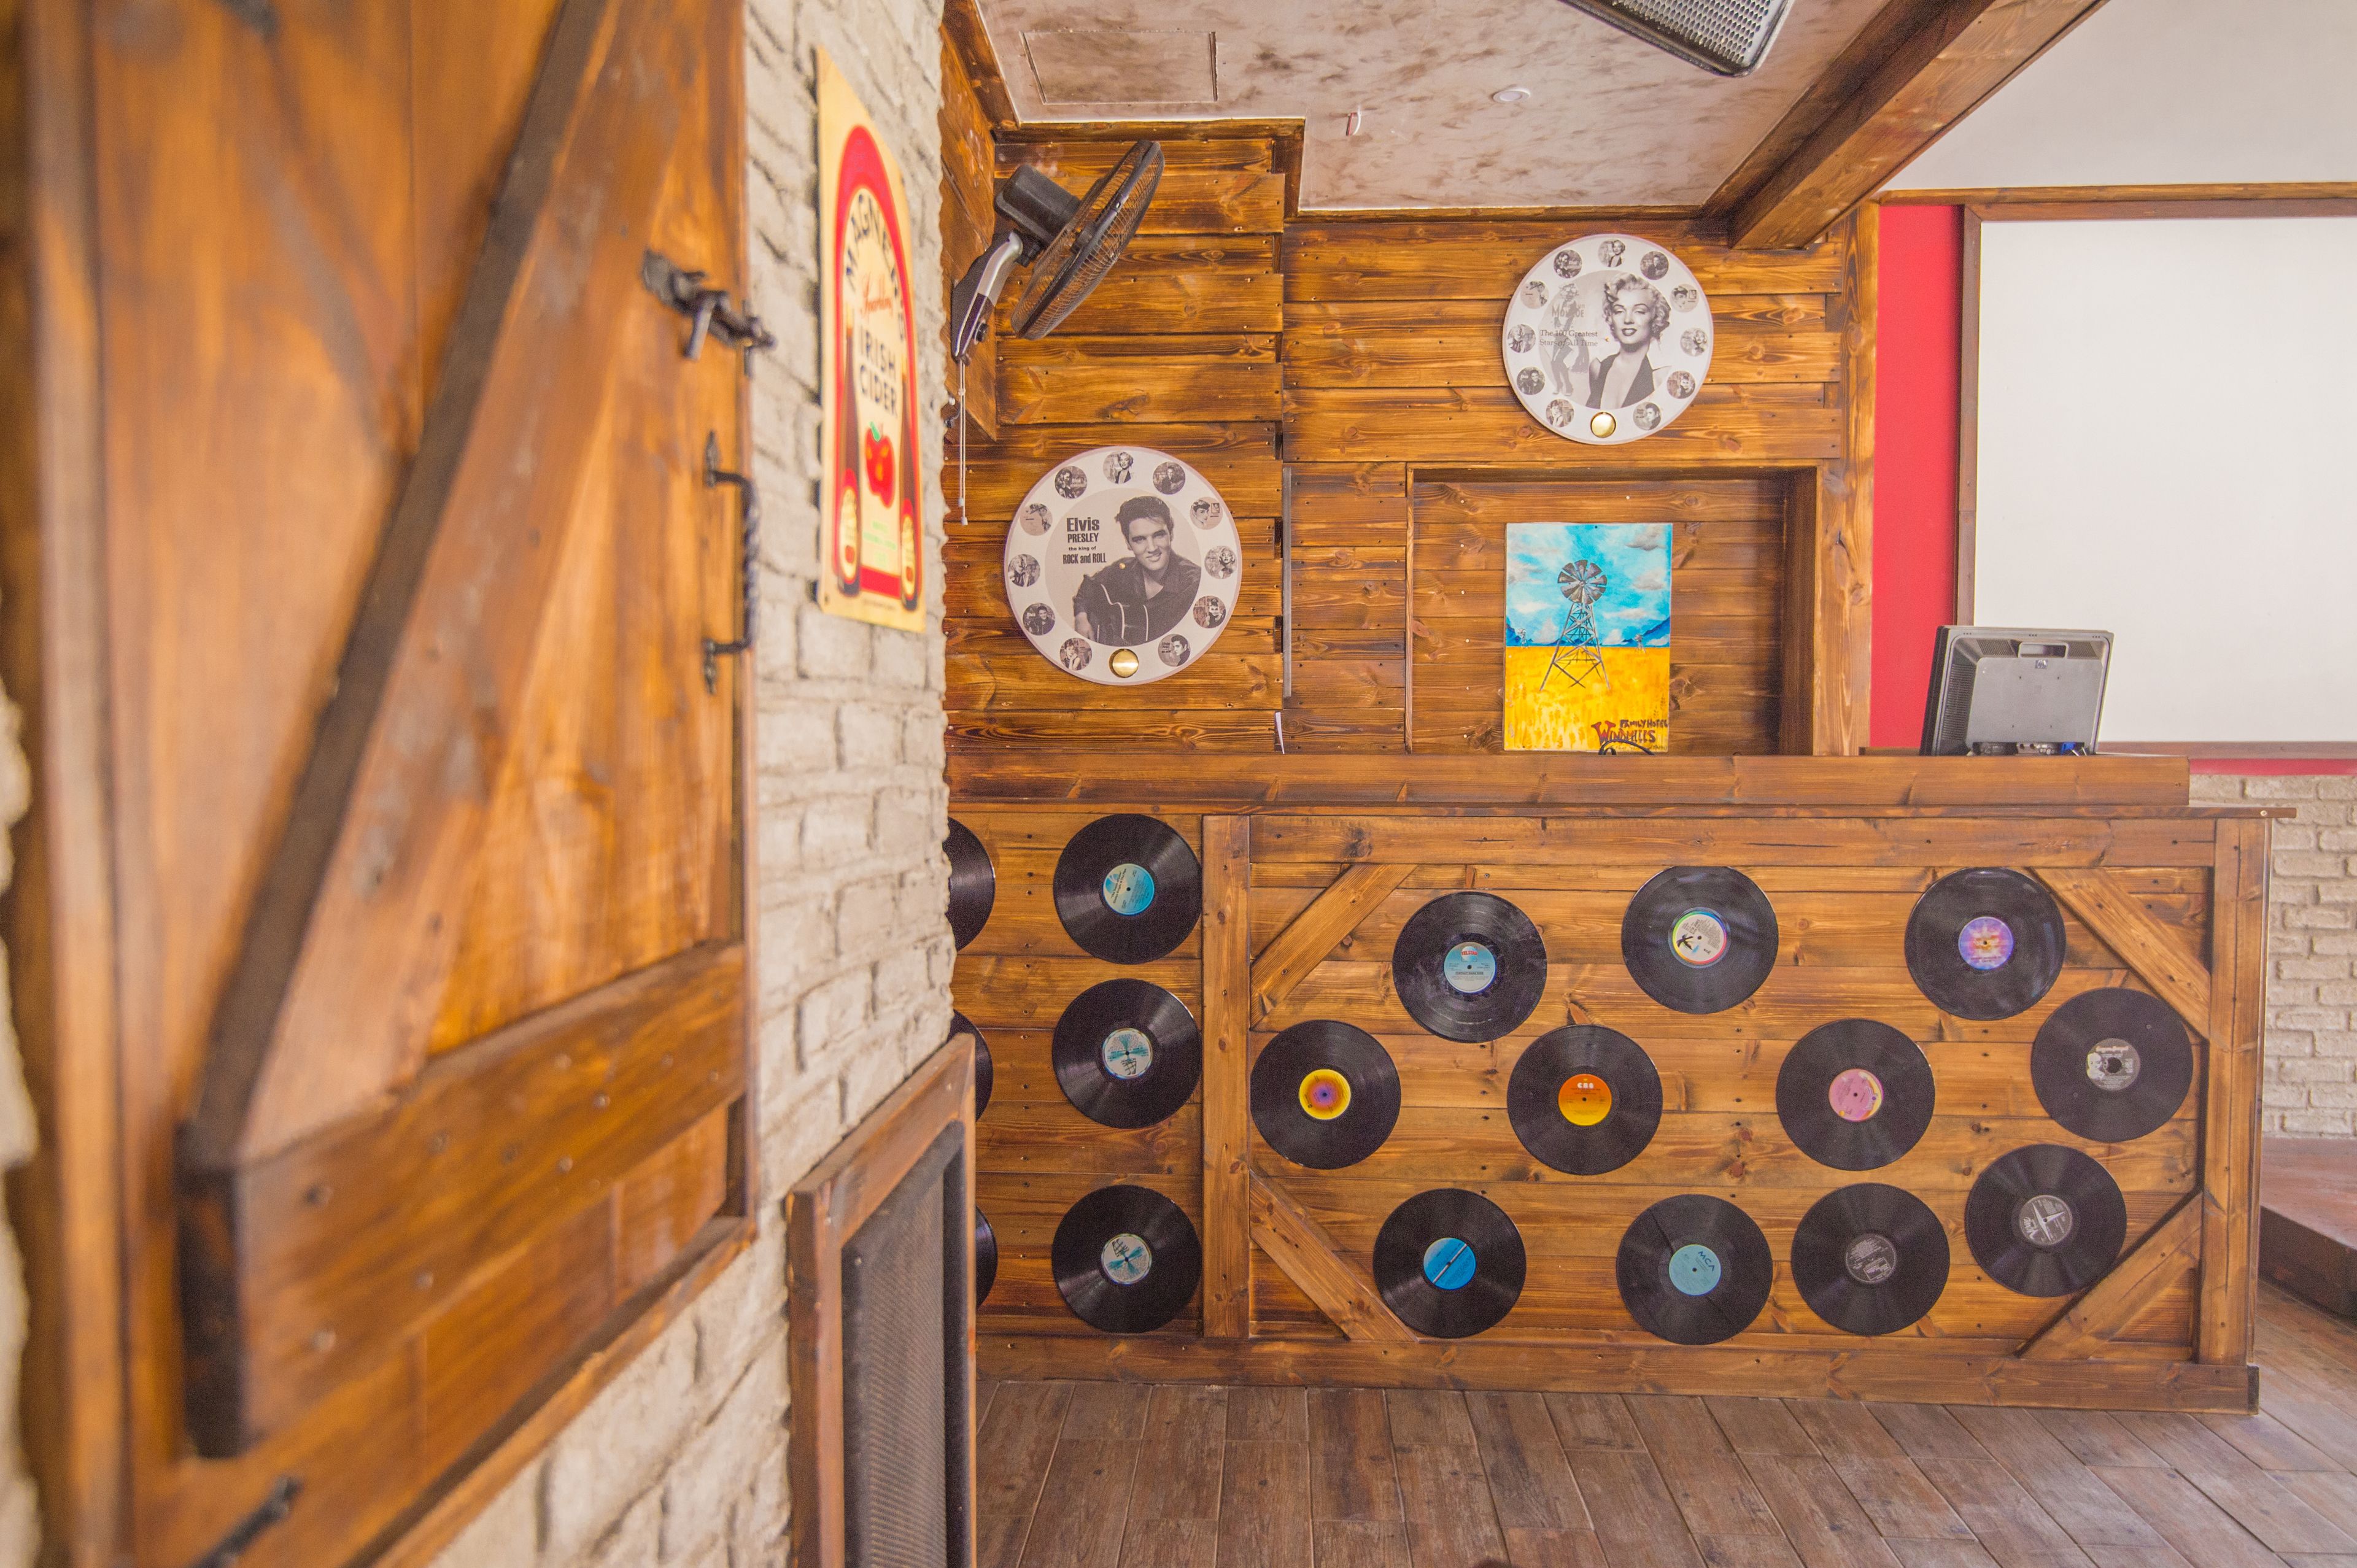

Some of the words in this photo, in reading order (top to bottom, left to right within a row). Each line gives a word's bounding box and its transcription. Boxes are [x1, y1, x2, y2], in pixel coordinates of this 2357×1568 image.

[1552, 304, 1584, 317] MOOE
[861, 325, 896, 382] IRISH
[860, 364, 898, 419] CIDER
[1066, 517, 1100, 532] Elvis
[1067, 533, 1099, 543] PRESLEY
[1062, 554, 1078, 564] ROCK
[1080, 553, 1091, 563] and
[1093, 552, 1107, 563] ROLL
[1620, 719, 1646, 728] FAMILY
[1698, 1251, 1715, 1272] MCA
